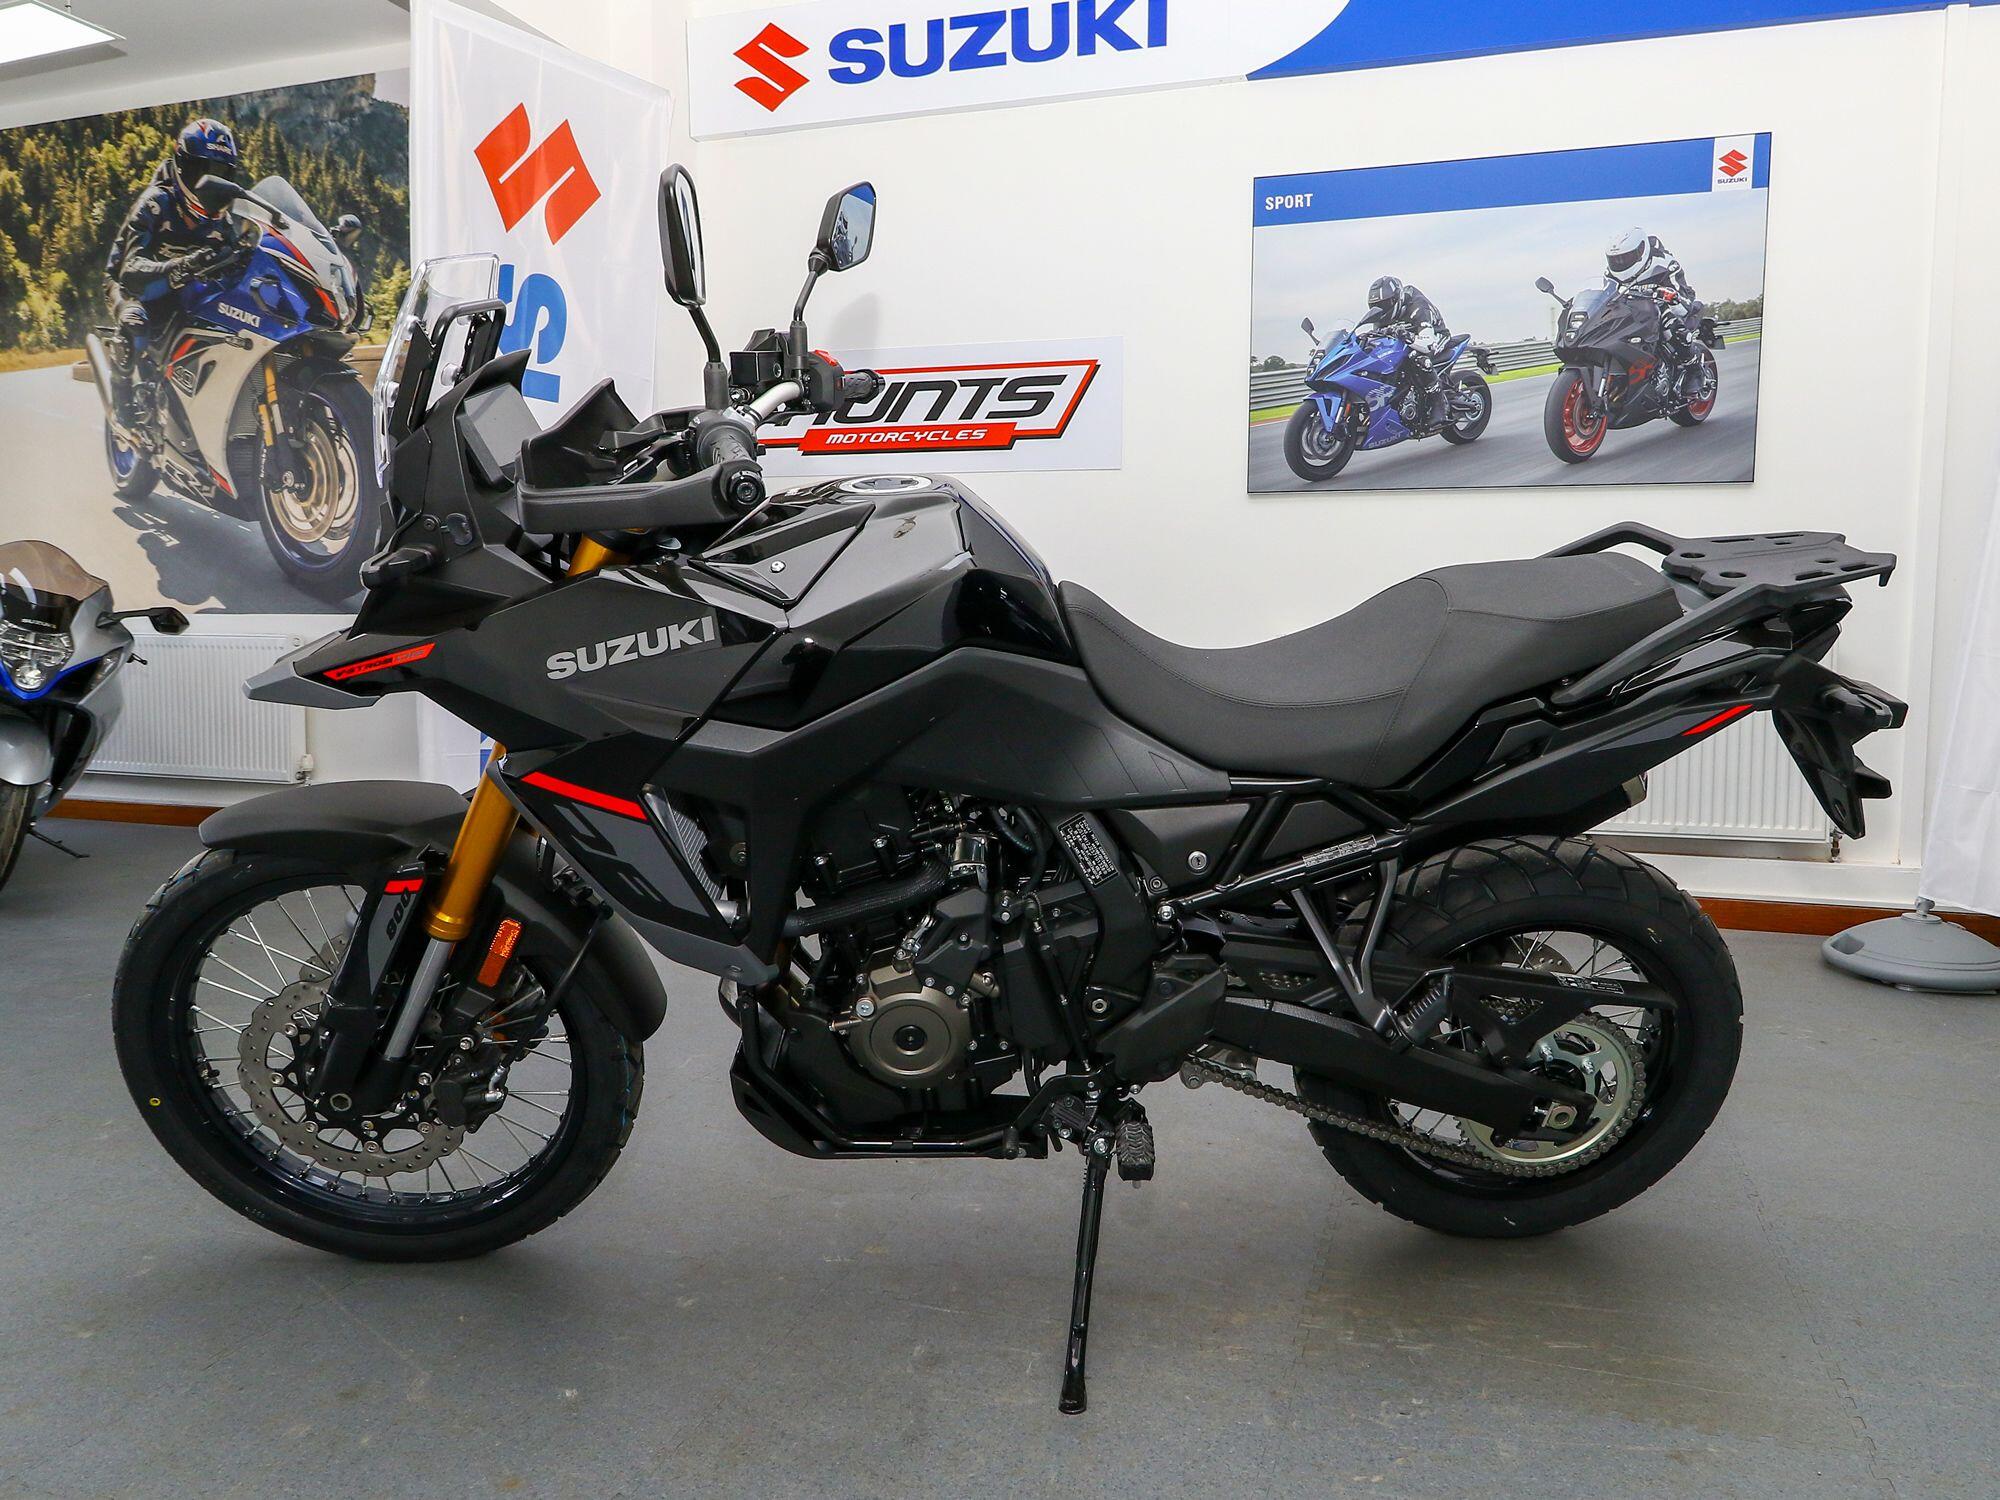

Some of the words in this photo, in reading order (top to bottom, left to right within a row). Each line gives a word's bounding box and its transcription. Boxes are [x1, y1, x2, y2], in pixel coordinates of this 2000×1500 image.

[828, 0, 1167, 85] SUZUKI
[1265, 193, 1313, 211] SPORT
[218, 302, 260, 328] SUZUKI
[826, 429, 988, 445] MOTORCYCLES
[546, 615, 716, 680] SUZUKI
